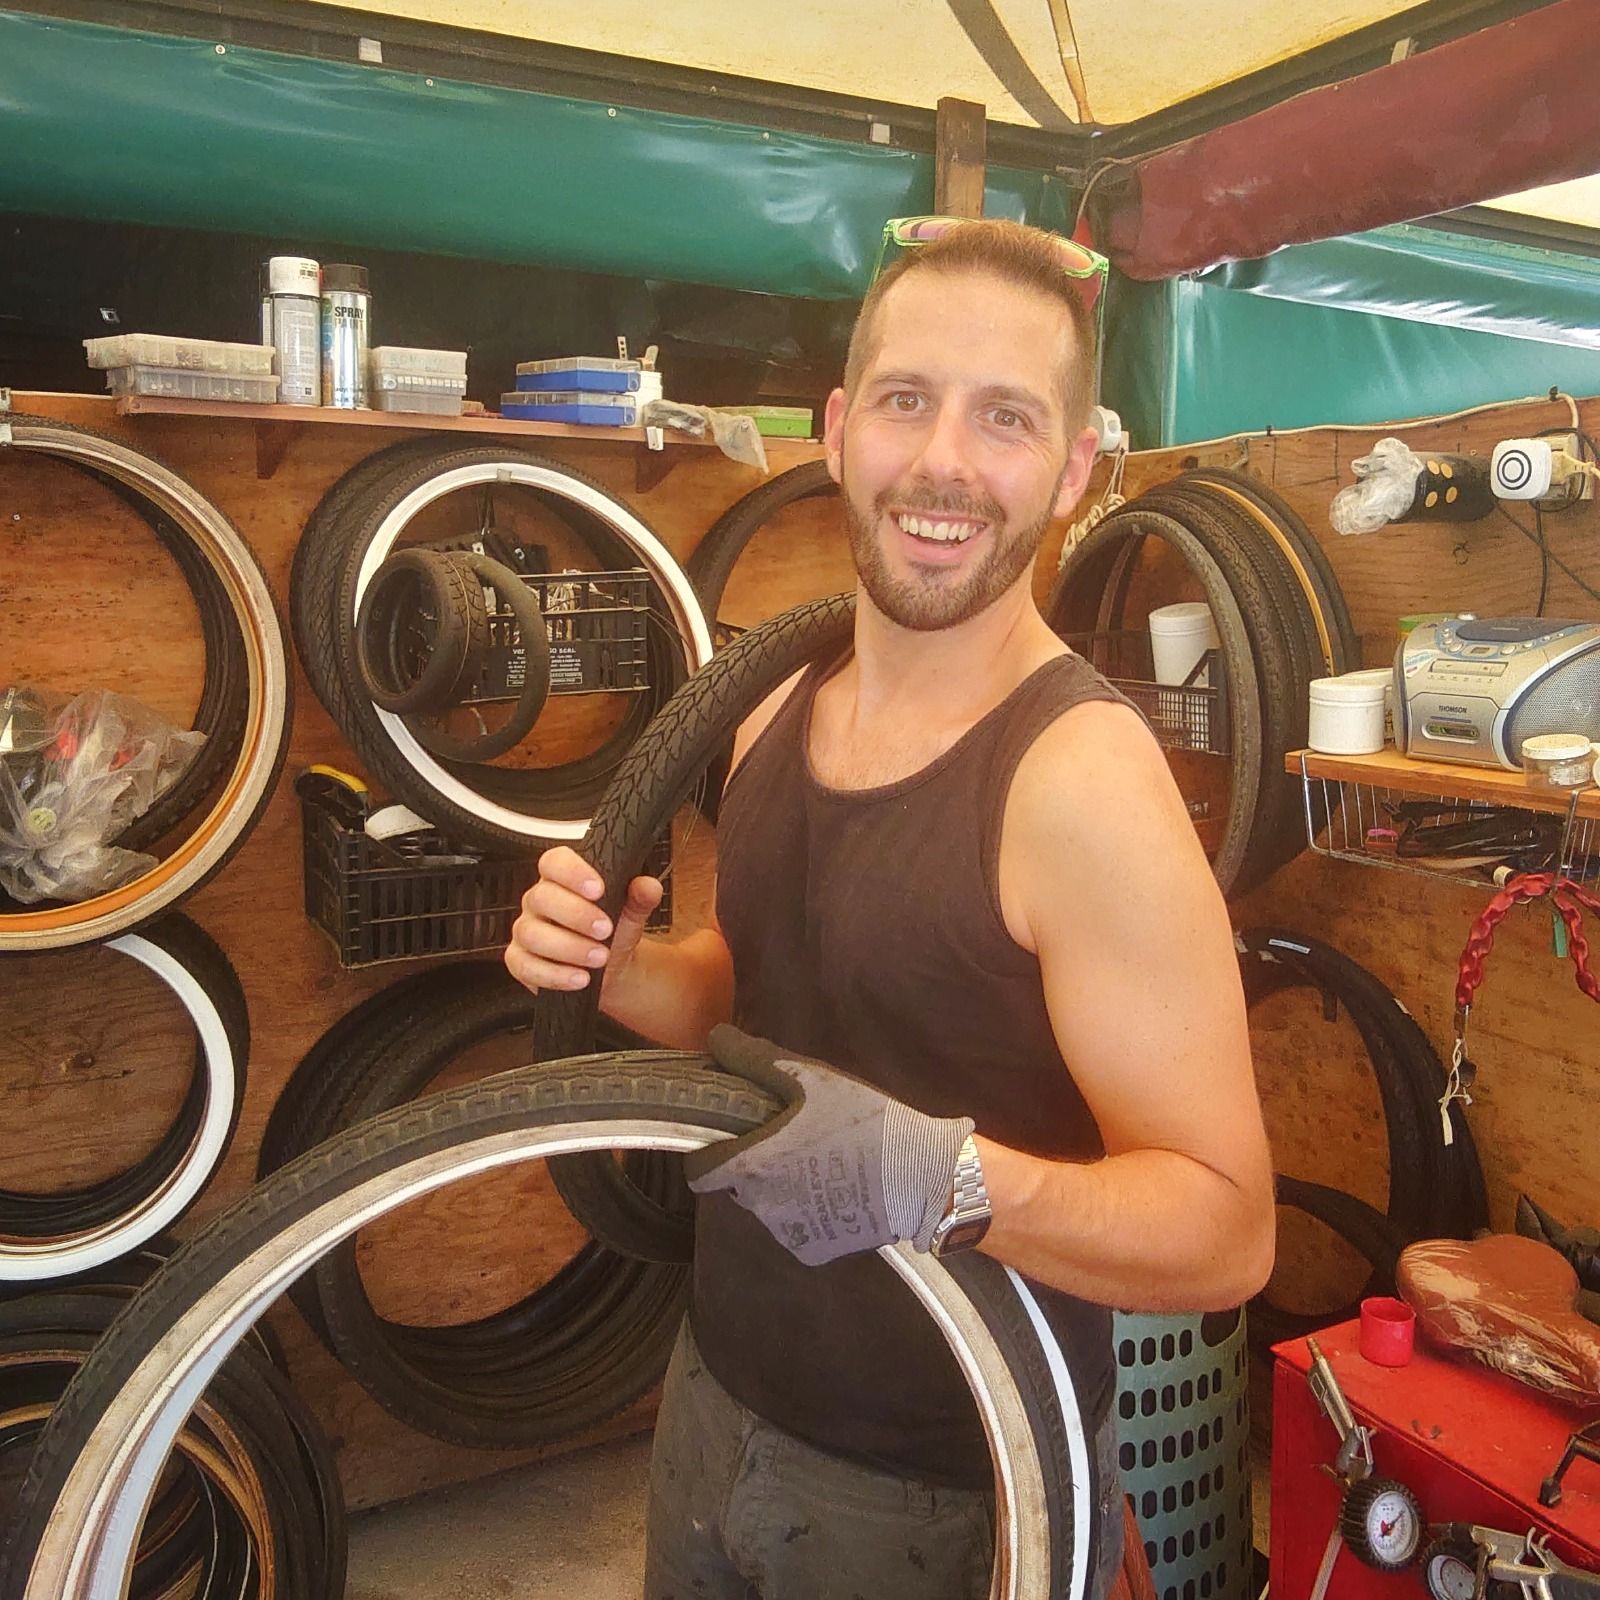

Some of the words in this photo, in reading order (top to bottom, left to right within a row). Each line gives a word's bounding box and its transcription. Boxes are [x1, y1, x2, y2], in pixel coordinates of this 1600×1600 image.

[334, 306, 364, 319] SPRAY
[334, 318, 364, 330] PAINT
[1438, 704, 1468, 714] THOMSON
